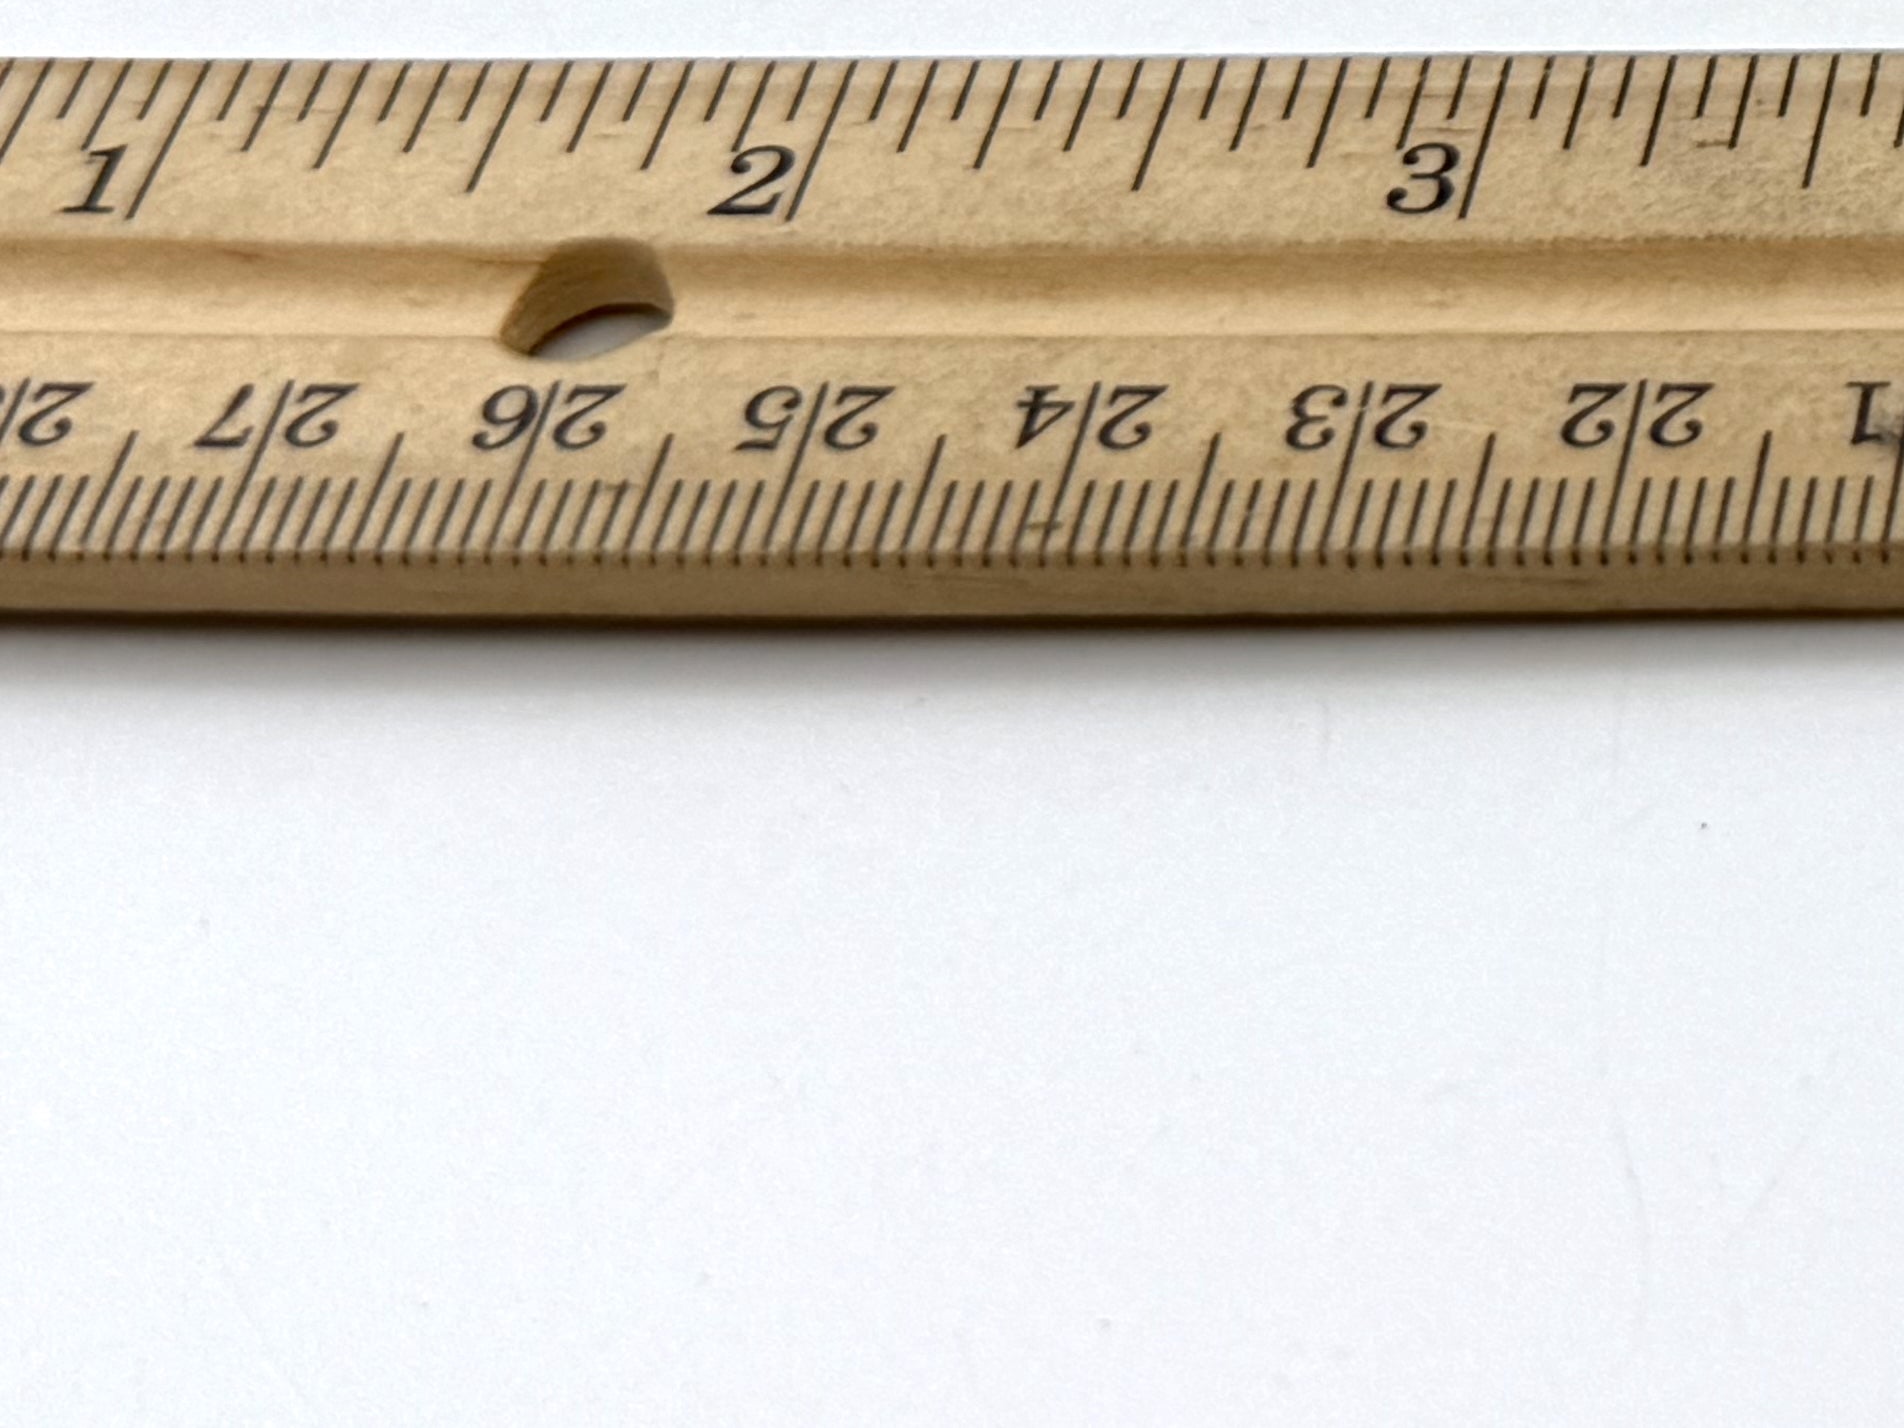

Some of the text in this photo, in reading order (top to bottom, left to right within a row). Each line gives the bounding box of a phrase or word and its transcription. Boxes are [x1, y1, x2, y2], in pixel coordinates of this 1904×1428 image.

[62, 145, 126, 215] 1
[706, 145, 797, 216] 2
[1385, 143, 1462, 214] 3
[0, 382, 93, 447] 2
[194, 382, 360, 450] 27
[472, 382, 626, 452] 26
[736, 385, 895, 452] 25
[1014, 384, 1169, 451] 24
[1284, 383, 1442, 452] 23
[1560, 382, 1715, 450] 22
